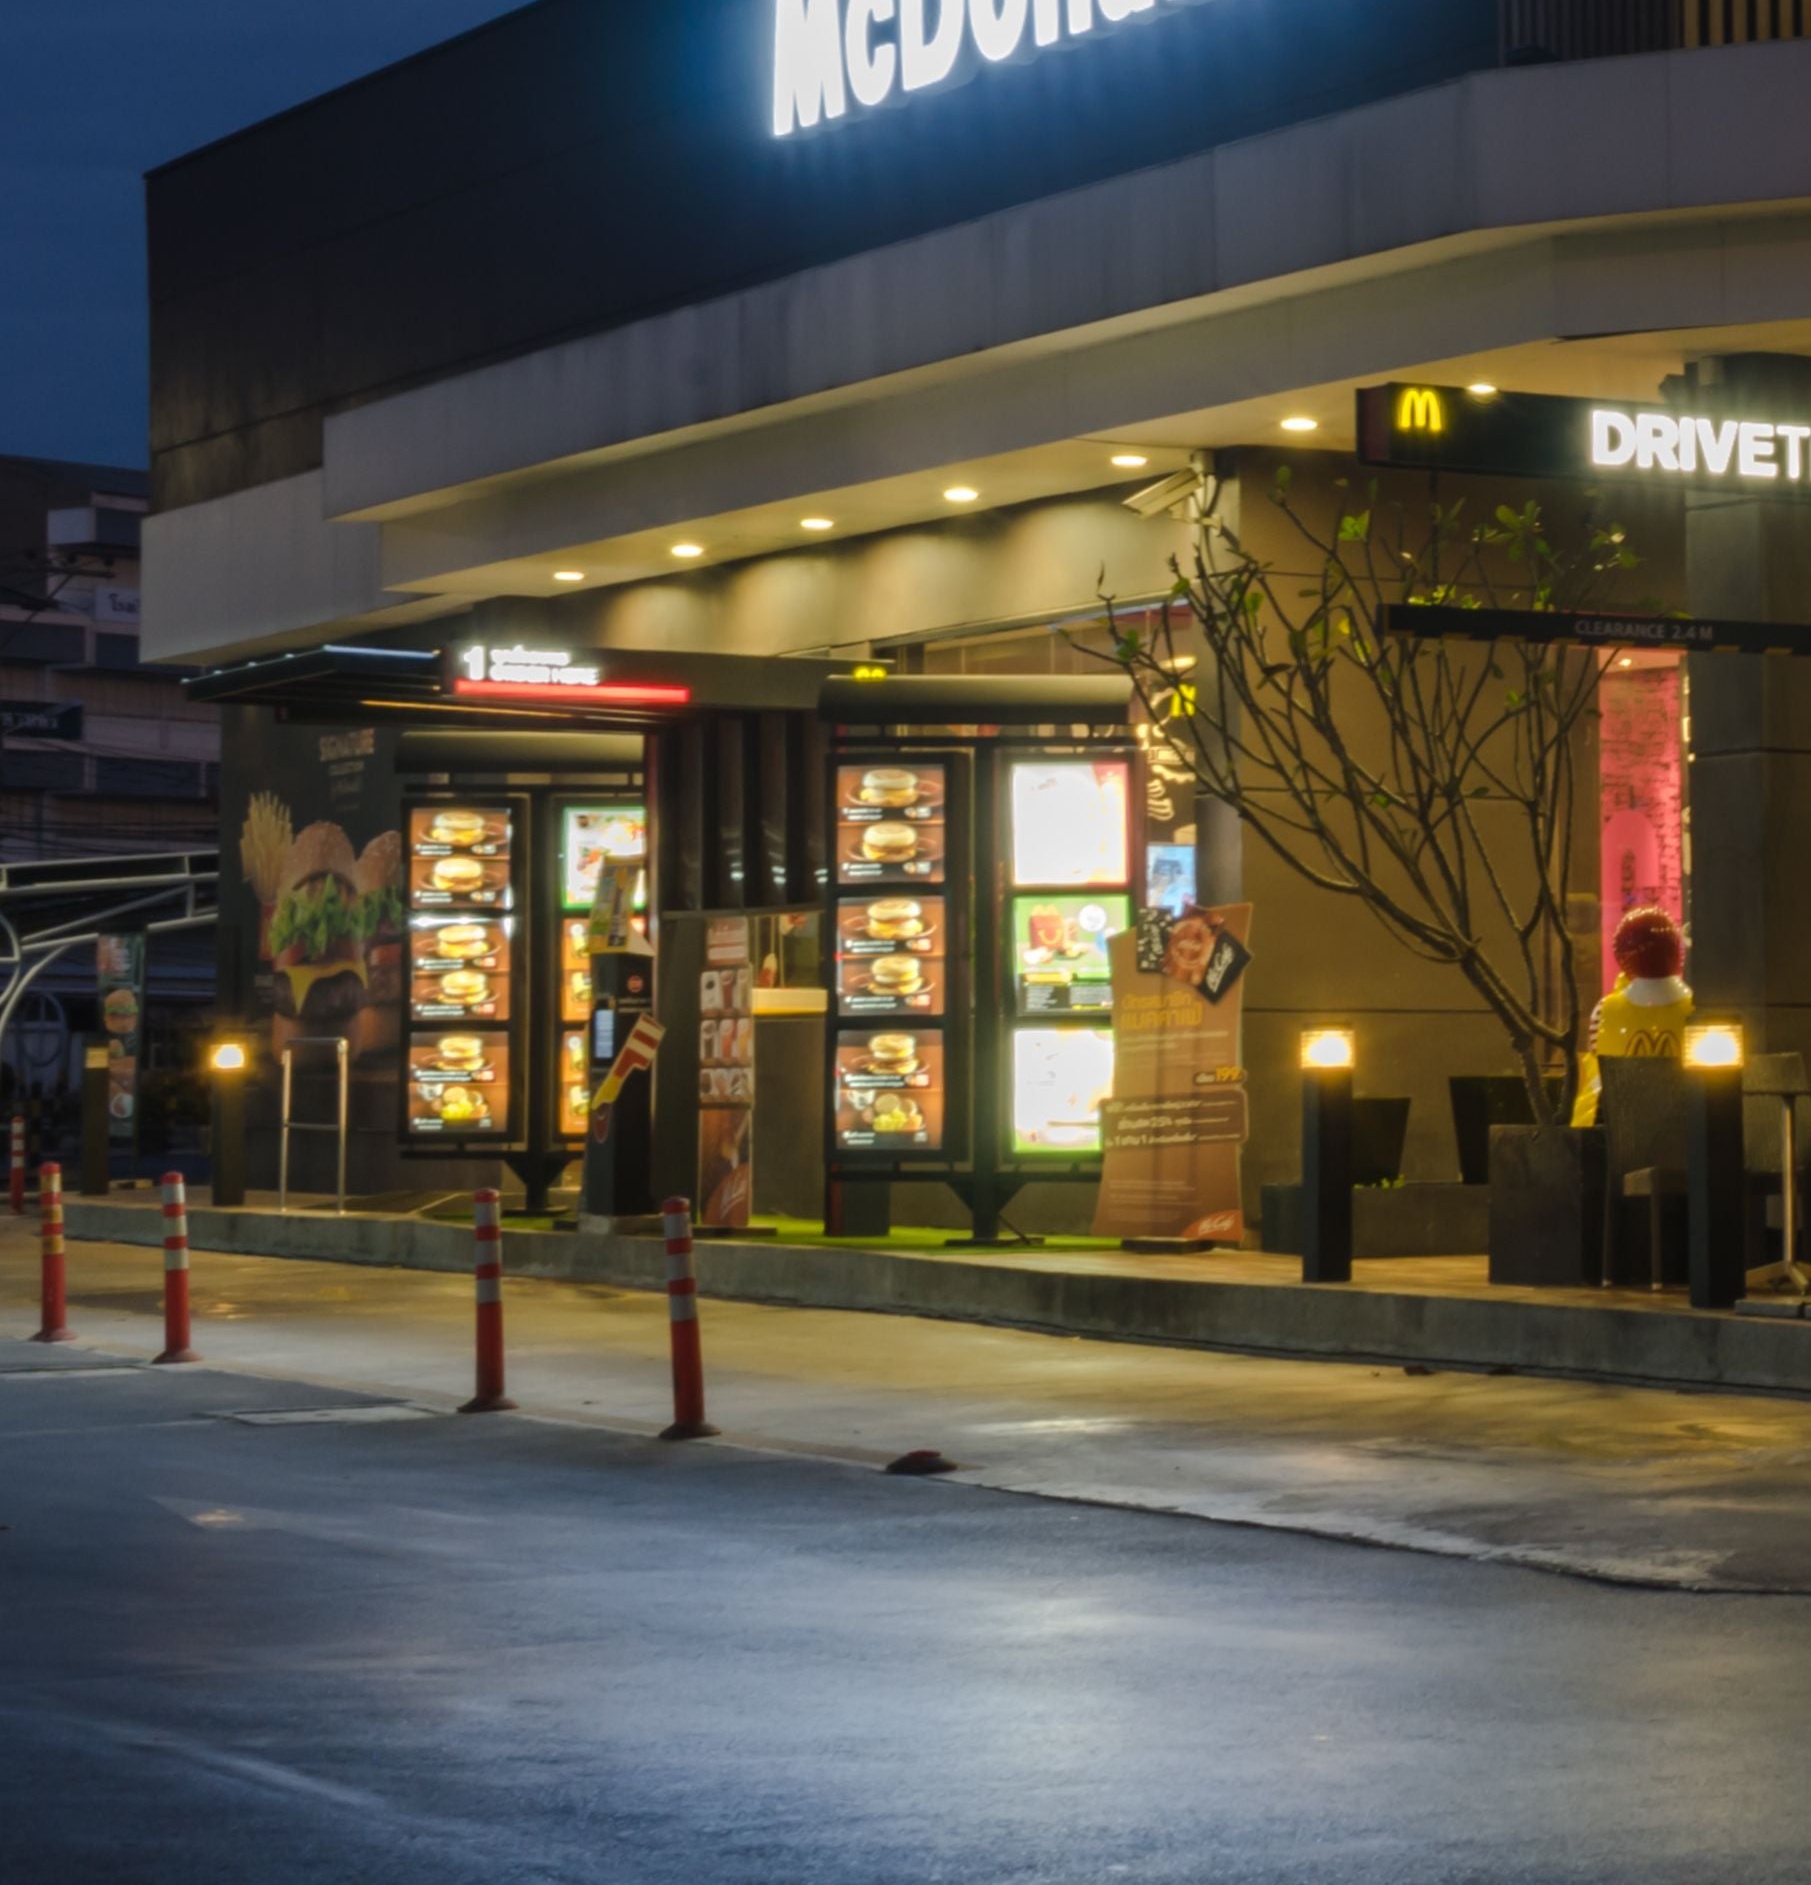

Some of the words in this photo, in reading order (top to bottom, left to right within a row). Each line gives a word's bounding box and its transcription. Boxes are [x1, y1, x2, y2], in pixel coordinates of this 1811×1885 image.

[1574, 618, 1665, 641] CLEARANCE
[1671, 623, 1698, 641] 2.4
[1699, 625, 1713, 641] M
